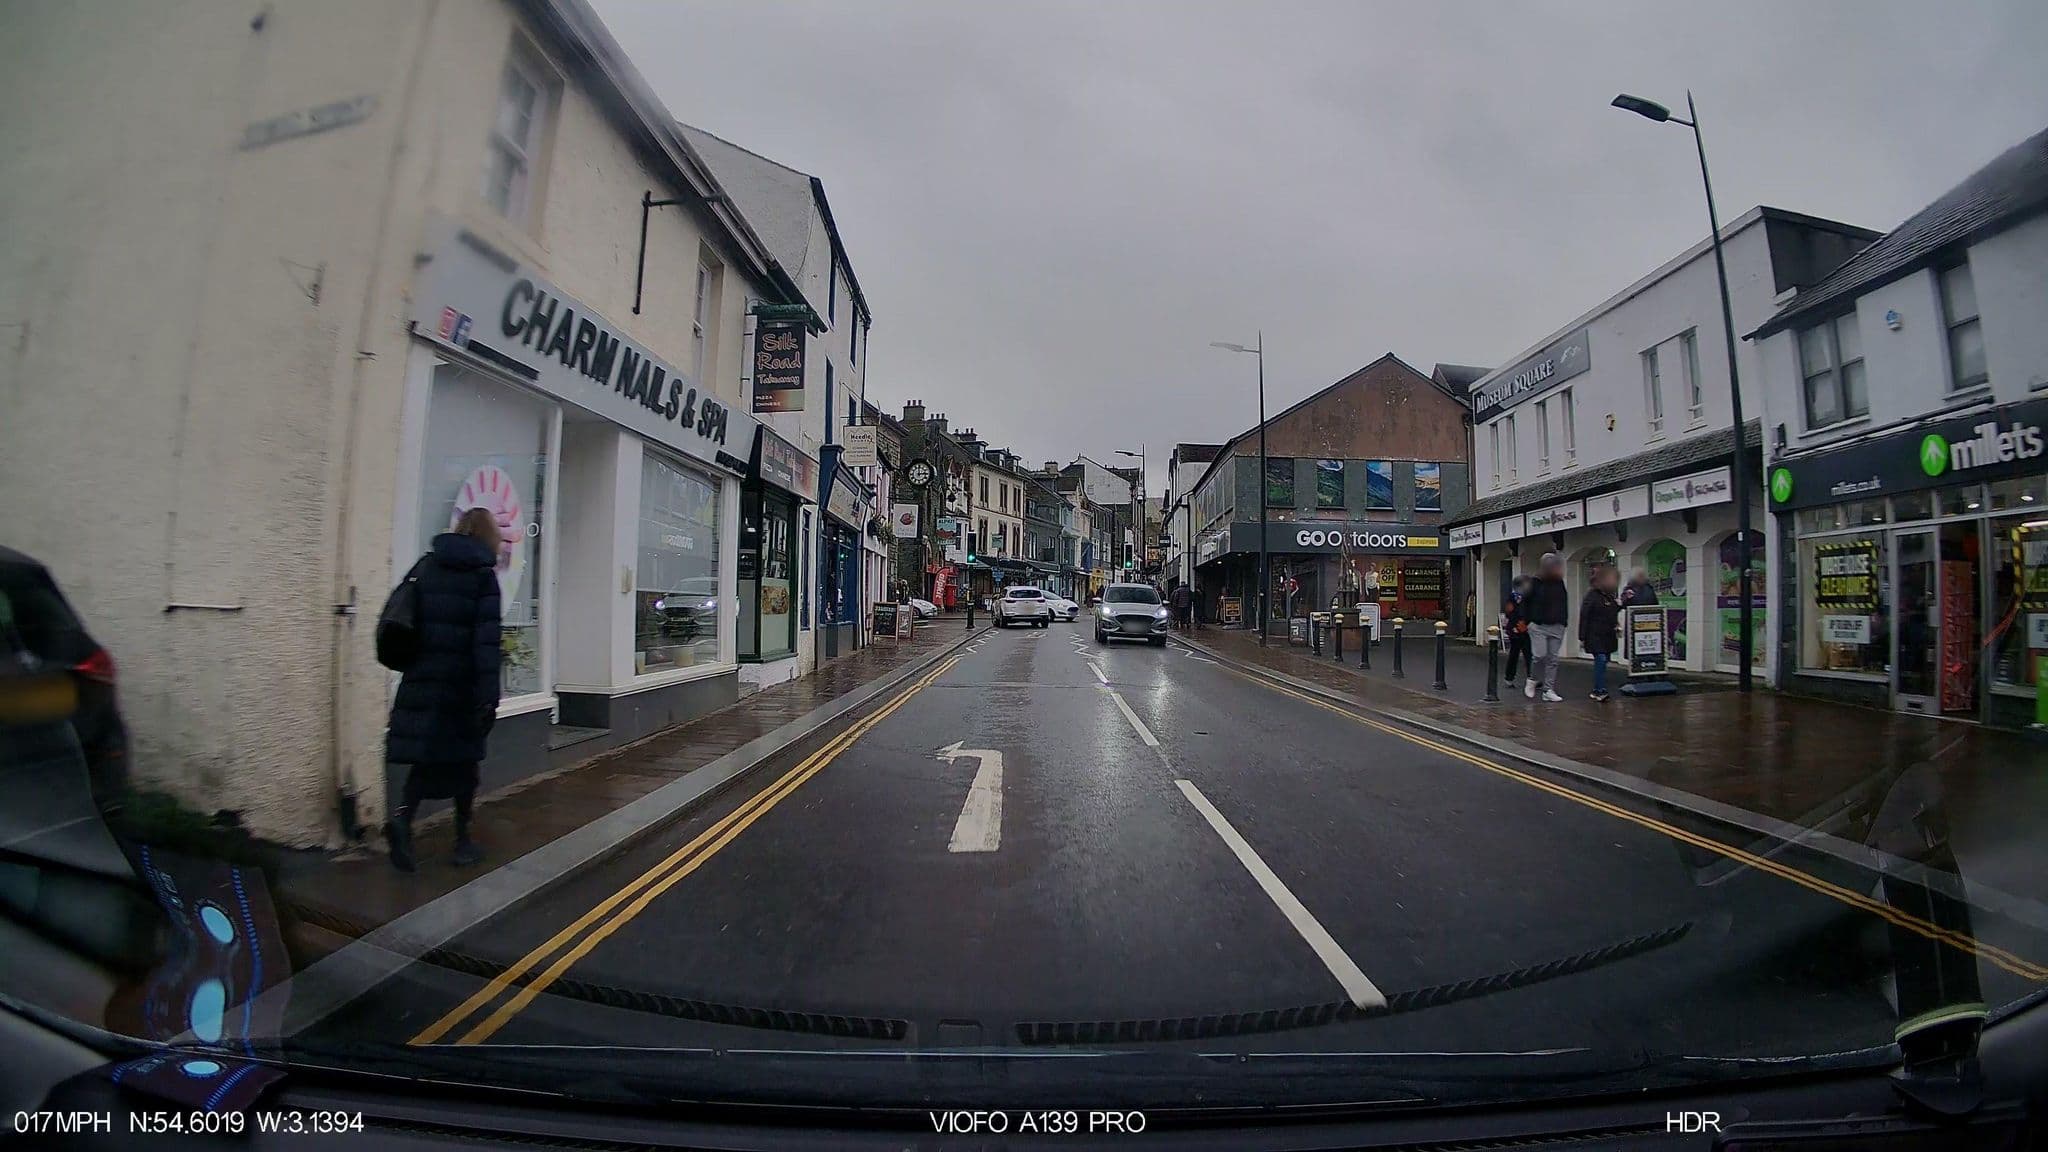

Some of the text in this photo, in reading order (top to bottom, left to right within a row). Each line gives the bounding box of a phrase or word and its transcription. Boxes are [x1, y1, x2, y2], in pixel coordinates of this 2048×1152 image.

[762, 331, 799, 351] Silk
[502, 278, 729, 447] CHARM NAILS & SPA
[756, 351, 802, 370] Road
[1476, 359, 1554, 414] MUSEUM SQUARE
[1950, 422, 2044, 471] millets
[1830, 476, 1882, 497] millets.co.uk
[1297, 530, 1407, 548] GO Otdoors
